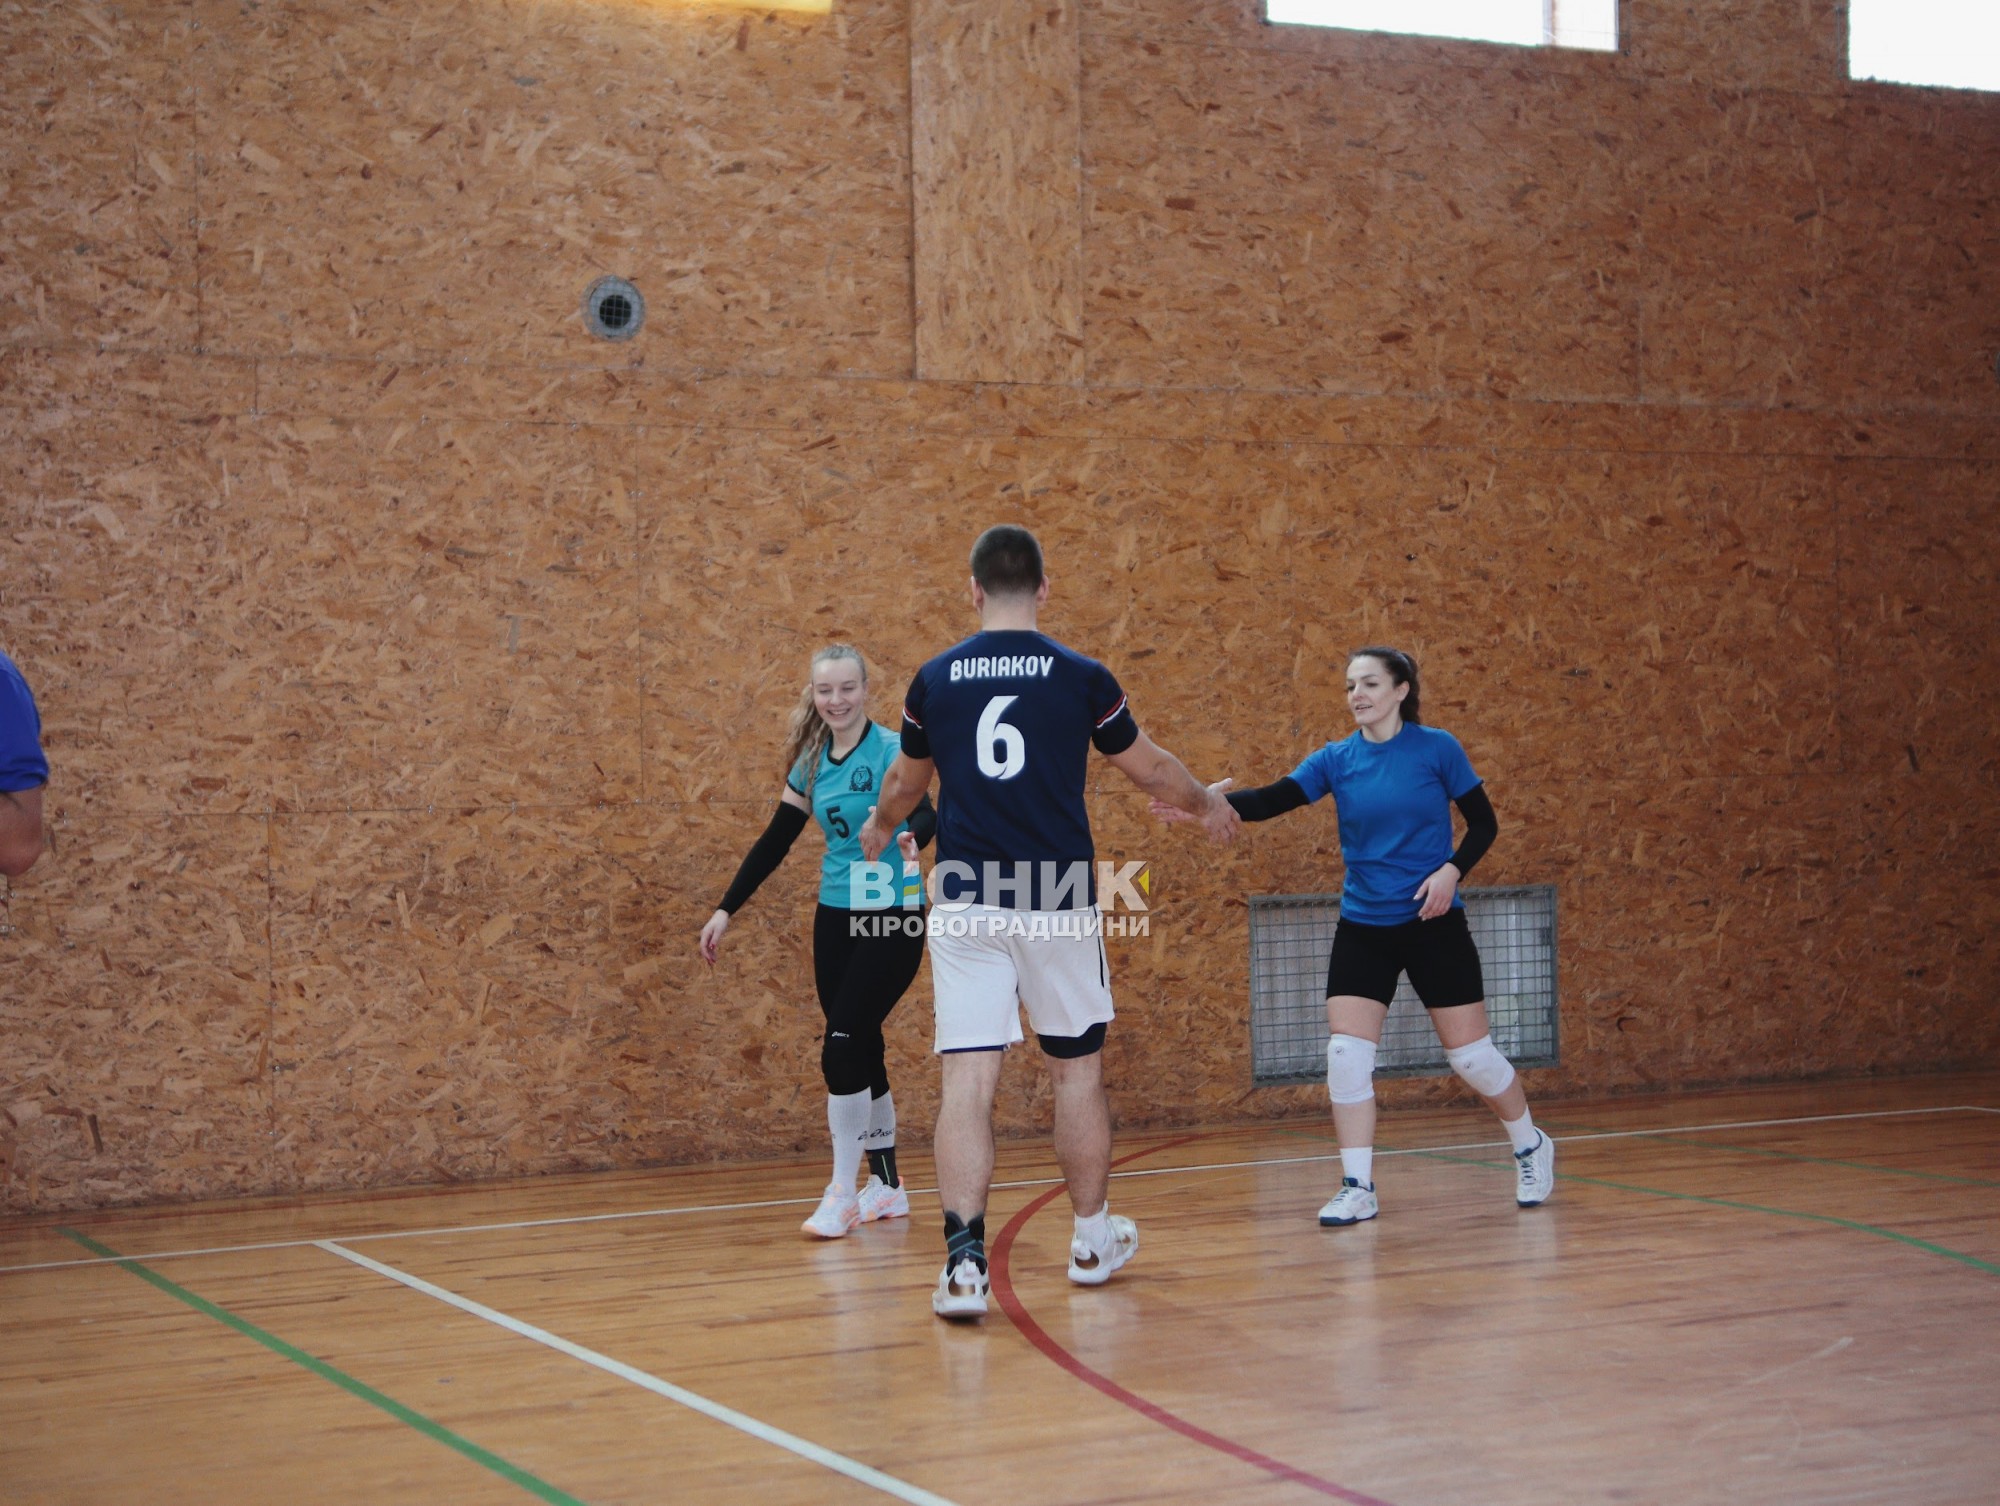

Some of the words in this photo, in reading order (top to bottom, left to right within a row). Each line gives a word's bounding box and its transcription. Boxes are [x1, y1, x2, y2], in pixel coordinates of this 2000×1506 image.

[950, 655, 1054, 681] BURIAKOV
[976, 695, 1025, 780] 6
[826, 806, 850, 839] 5
